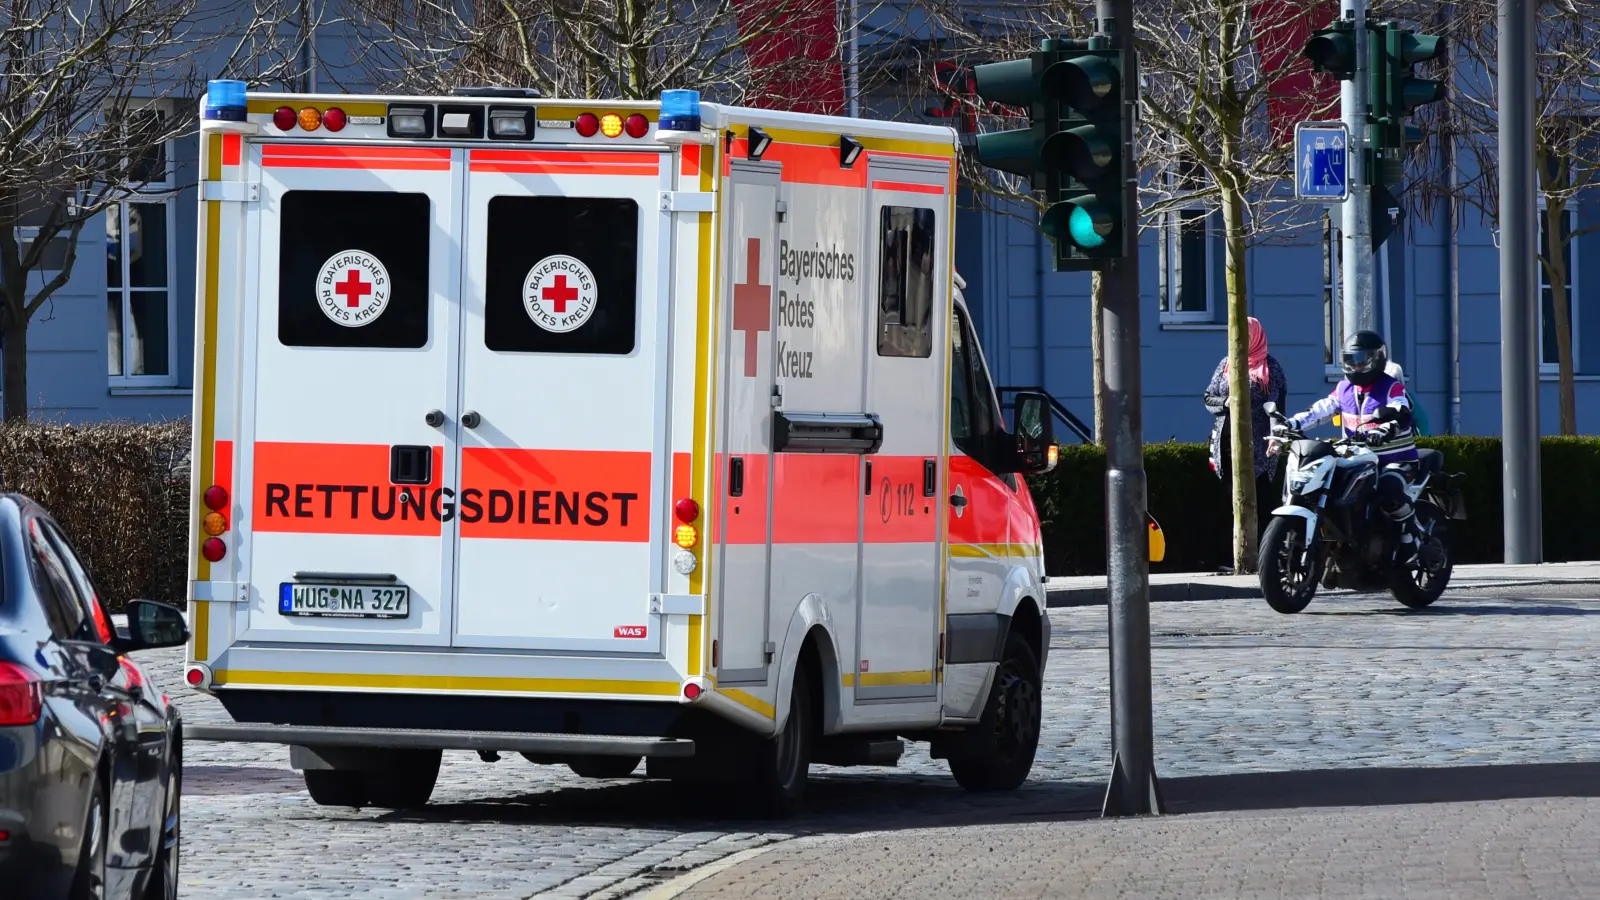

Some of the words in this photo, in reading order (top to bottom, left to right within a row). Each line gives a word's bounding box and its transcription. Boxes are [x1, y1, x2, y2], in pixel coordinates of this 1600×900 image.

[323, 255, 385, 286] BAYERISCHES
[529, 260, 592, 291] BAYERISCHES
[779, 239, 854, 286] Bayerisches
[322, 289, 350, 321] ROTES
[355, 291, 385, 321] KREUZ
[528, 295, 557, 326] ROTES
[562, 296, 592, 327] KREUZ
[778, 290, 814, 328] Rotes
[776, 340, 813, 378] Kreuz
[265, 483, 639, 527] RETTUNGSDIENST
[897, 483, 915, 516] 112
[293, 588, 329, 609] WUG
[341, 589, 364, 609] NA
[371, 589, 406, 611] 327
[618, 627, 642, 636] WAS
